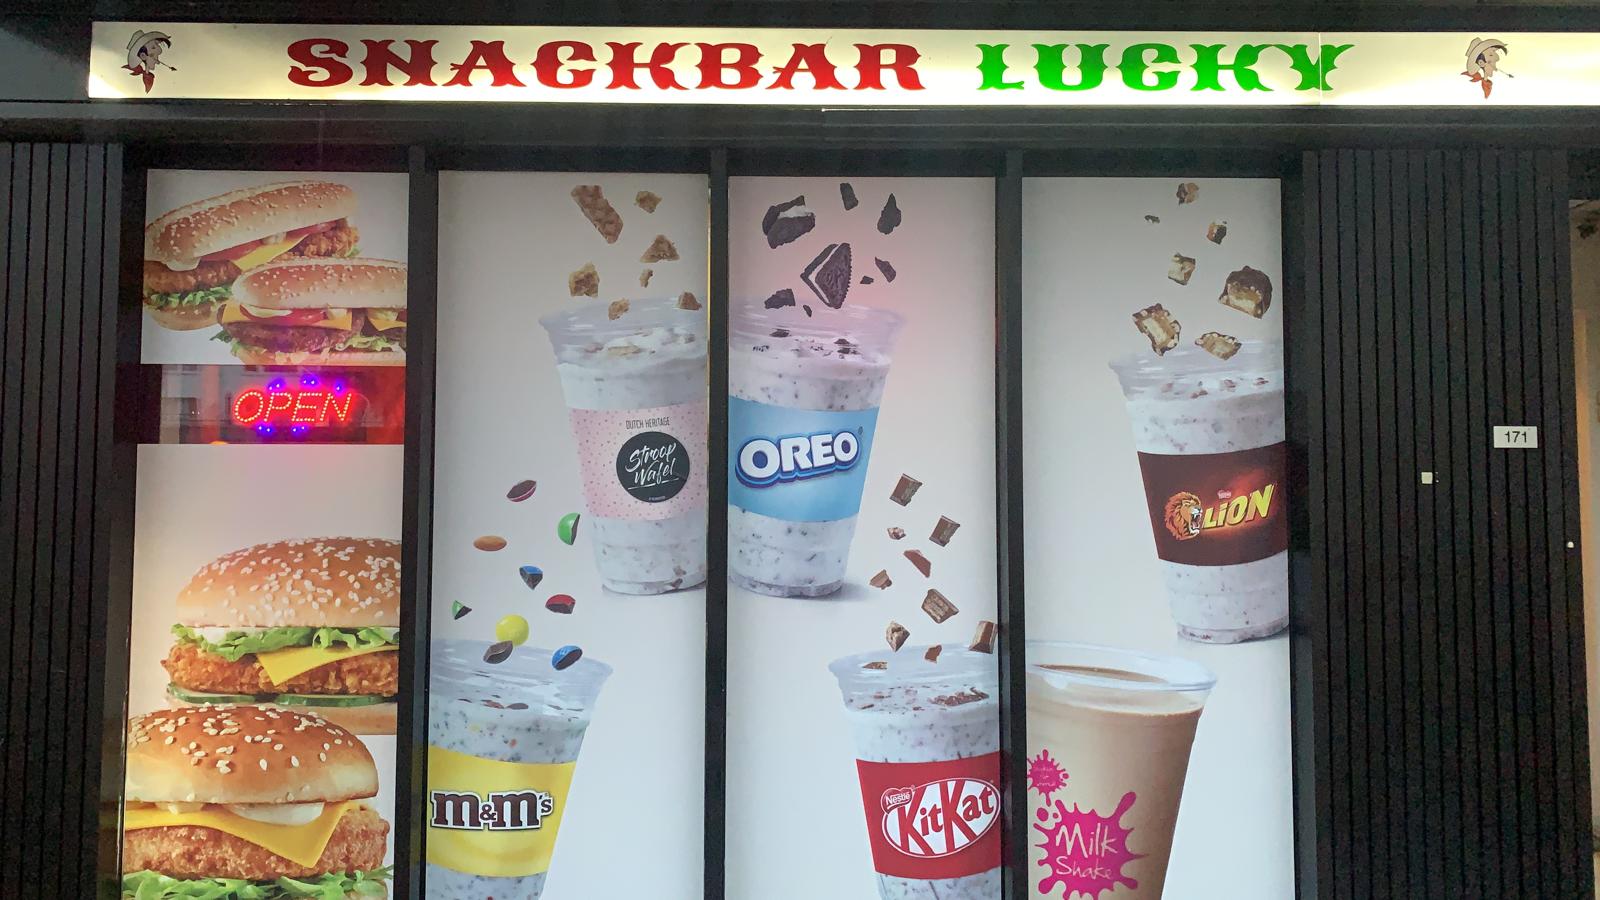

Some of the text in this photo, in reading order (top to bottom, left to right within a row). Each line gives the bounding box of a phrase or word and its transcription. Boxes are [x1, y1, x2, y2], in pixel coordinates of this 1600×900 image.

[287, 38, 1354, 91] SNACKBAR LUCKY
[233, 390, 354, 424] OPEN
[625, 416, 671, 430] DUTCH HERITAGE
[1504, 430, 1528, 443] 171
[628, 442, 677, 473] Stroop
[634, 458, 675, 486] Wafel
[738, 430, 860, 484] OREO
[432, 792, 552, 829] m&m's
[1055, 822, 1118, 858] Milk
[1056, 855, 1113, 879] Shake
